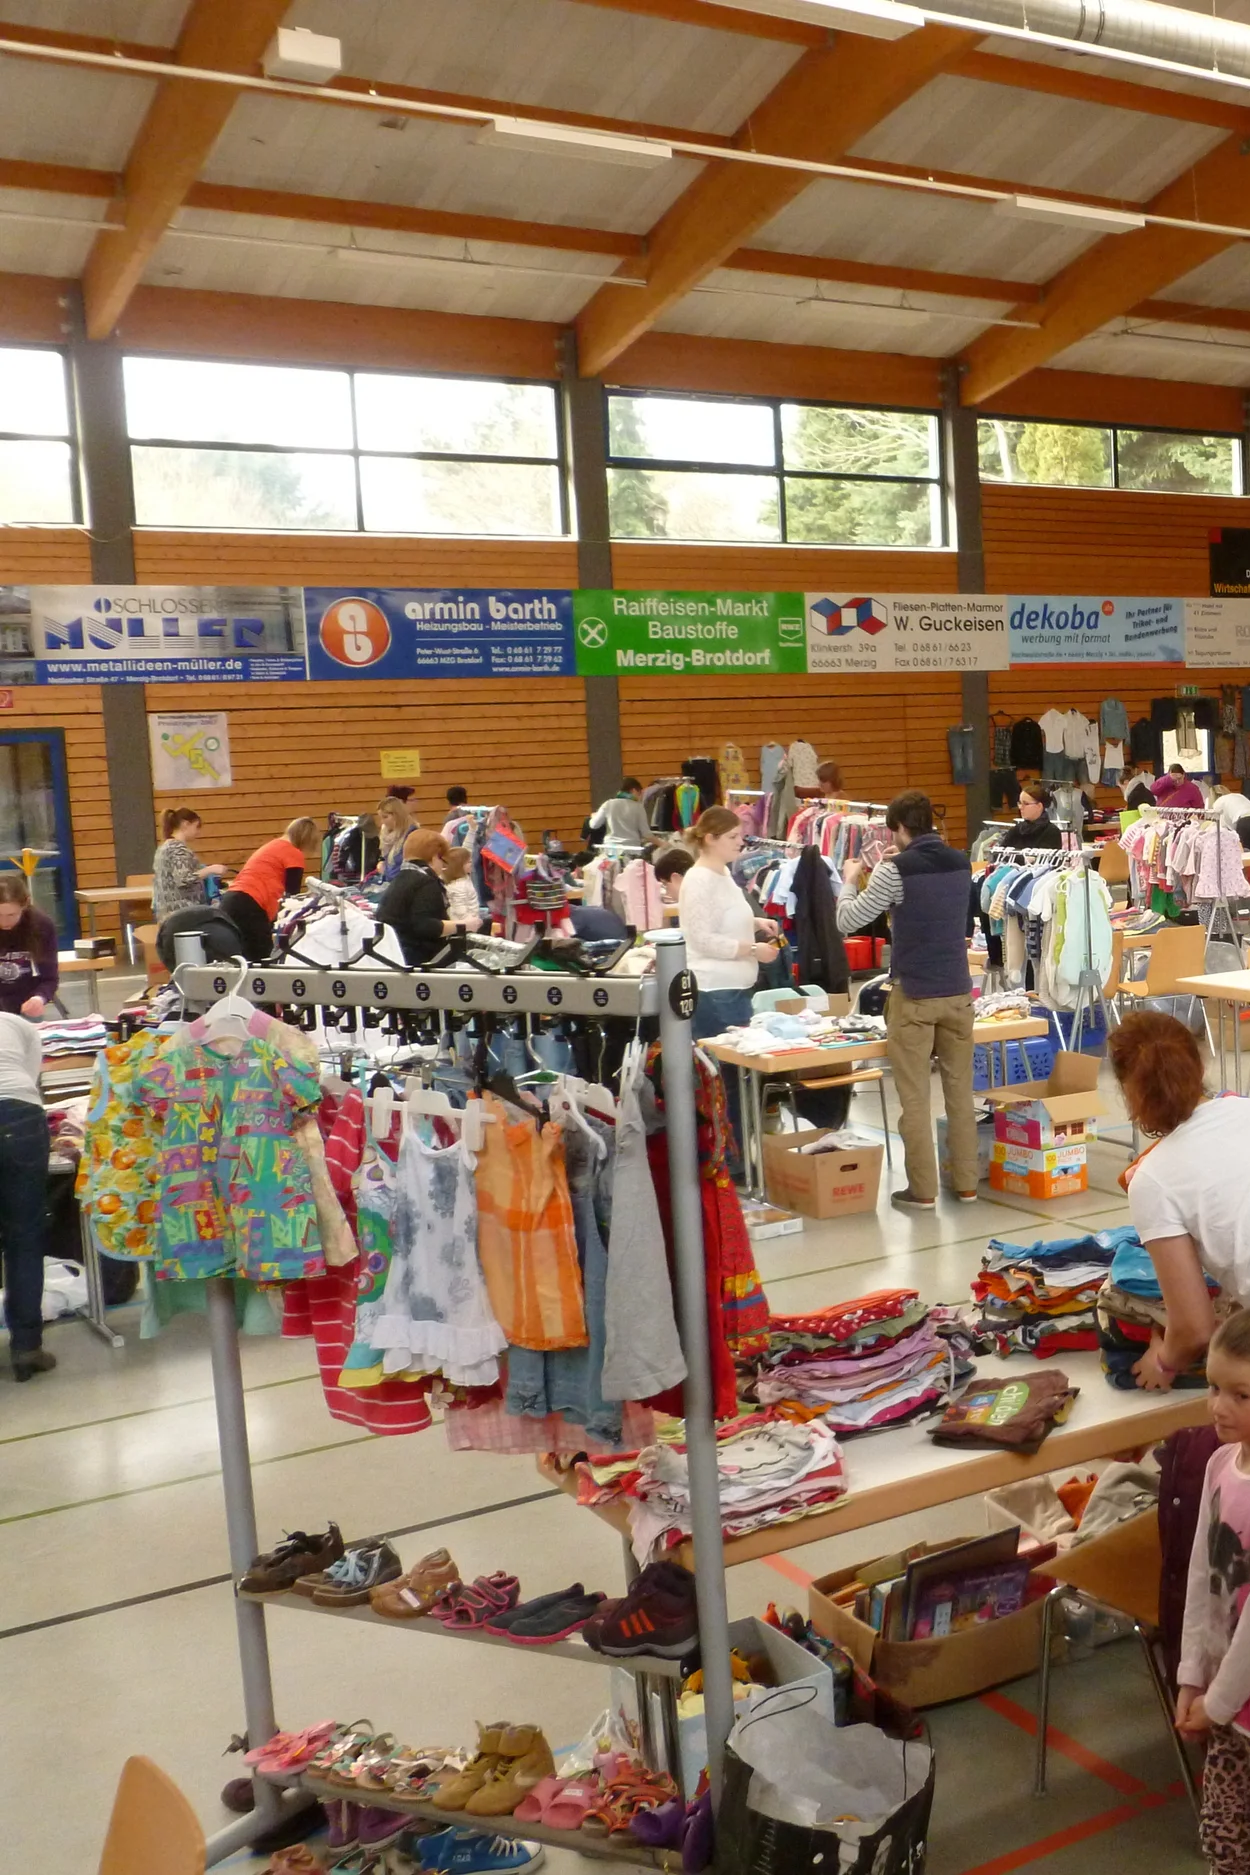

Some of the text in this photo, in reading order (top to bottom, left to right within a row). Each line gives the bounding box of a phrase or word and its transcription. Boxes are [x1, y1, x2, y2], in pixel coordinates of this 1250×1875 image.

[405, 596, 556, 619] armin barth
[613, 597, 769, 616] Raiffeisen-Markt
[893, 602, 1003, 613] Fliesen-Platten-Marmor
[1125, 611, 1135, 620] Ihr
[1136, 607, 1162, 618] Partner
[894, 615, 1004, 632] W. Guckeisen
[1010, 603, 1101, 630] dekoba
[1155, 616, 1168, 624] und
[416, 621, 562, 632] Heizungsbau Meisterbetrieb
[648, 621, 738, 639] Baustoffe
[1021, 632, 1111, 646] werbung mit format
[1124, 625, 1178, 643] Bandenwerbung
[47, 659, 243, 673] www.metallideen-müller.de
[616, 649, 770, 671] Merzig-Brotdorf
[845, 658, 877, 669] Merzig
[895, 657, 910, 666] Fax
[681, 976, 692, 990] 81
[679, 998, 694, 1014] 120
[1008, 1147, 1034, 1160] JUMBO
[1058, 1146, 1085, 1159] JUMBO
[832, 1183, 865, 1198] REWE
